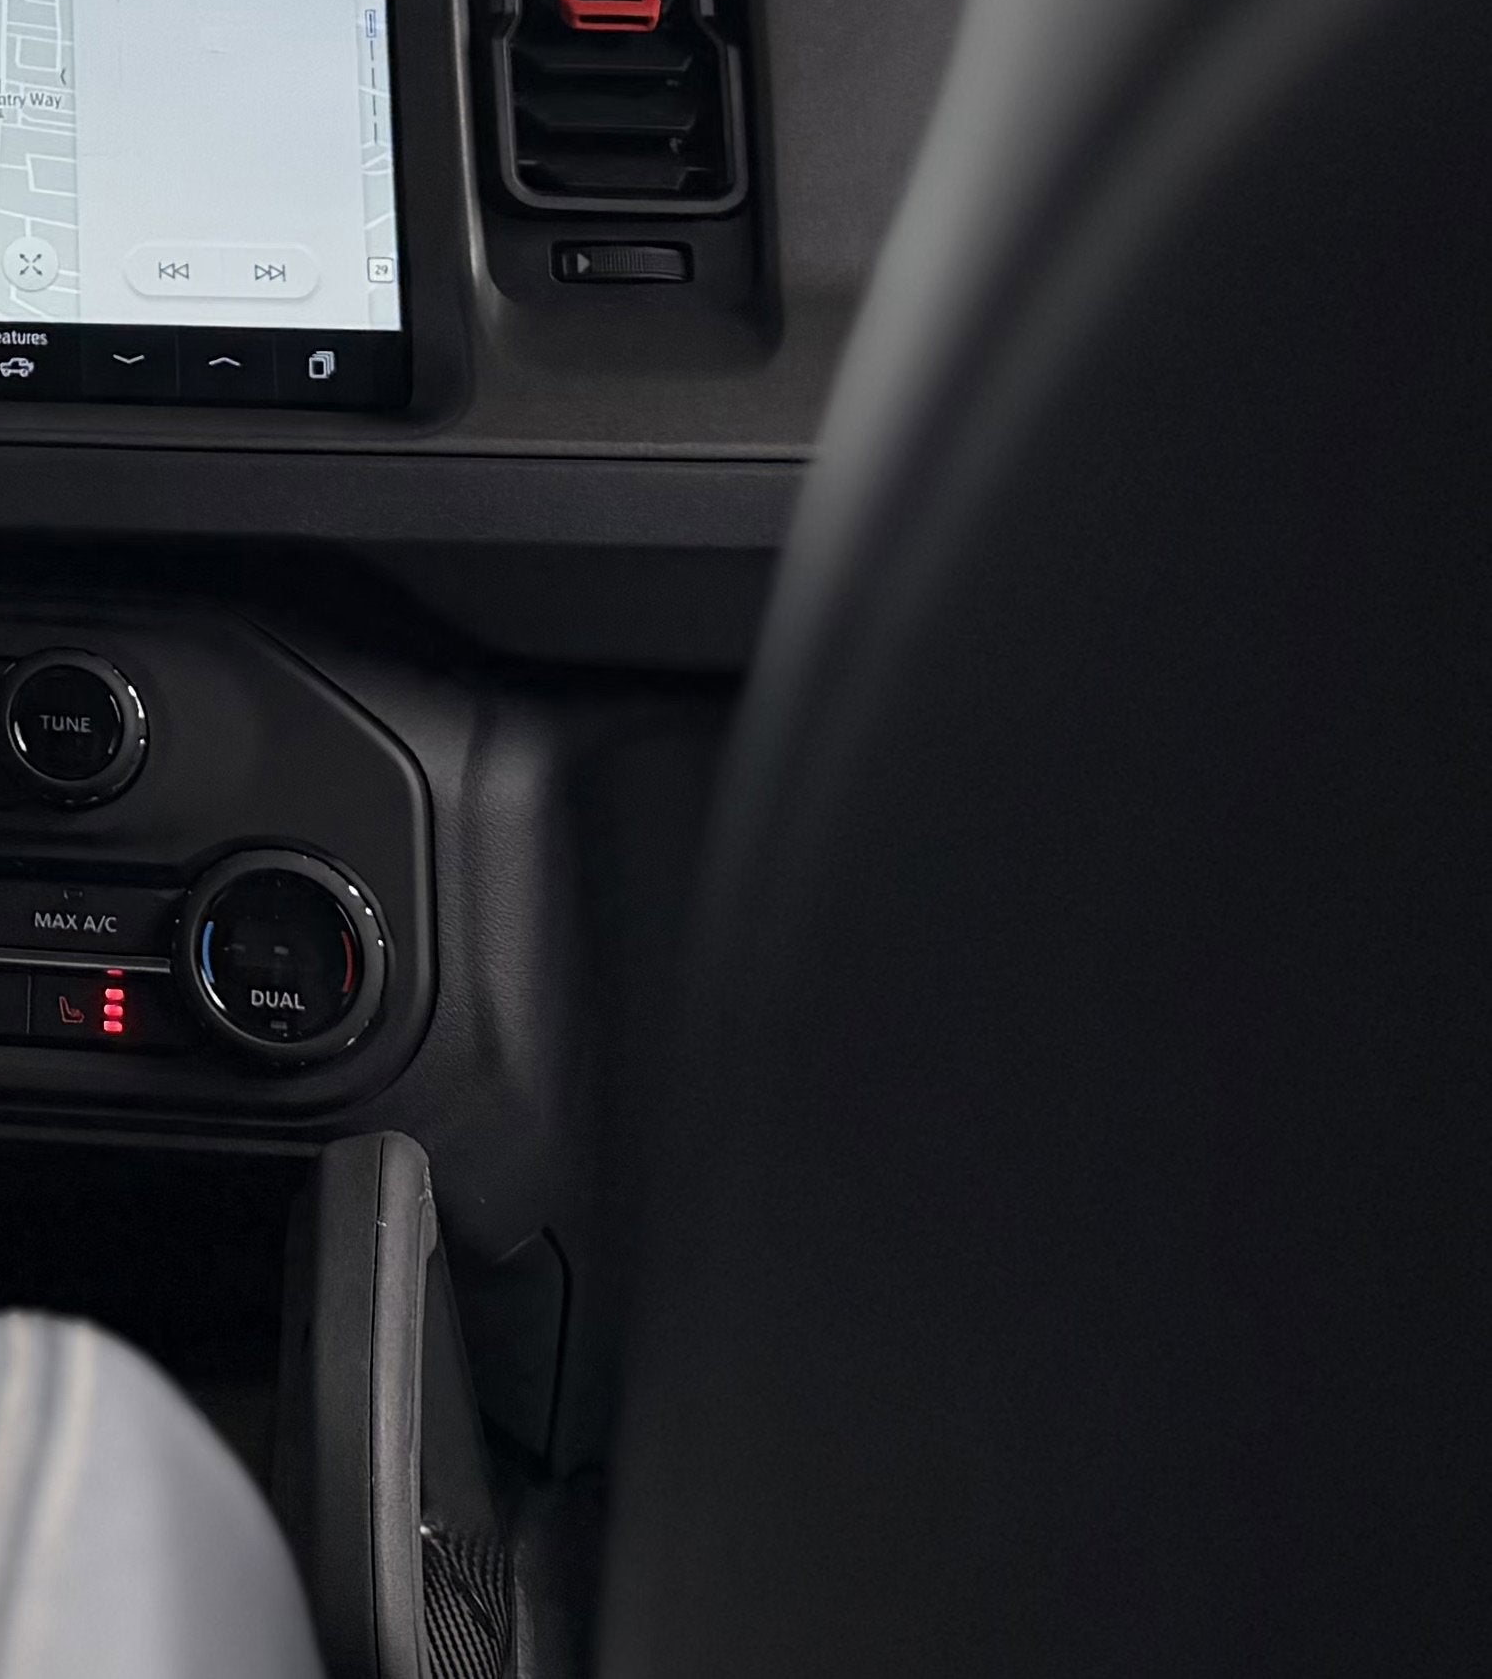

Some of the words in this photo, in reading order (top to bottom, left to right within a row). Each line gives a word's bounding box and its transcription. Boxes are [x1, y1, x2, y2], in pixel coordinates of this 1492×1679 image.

[29, 93, 63, 109] Way
[374, 264, 389, 276] 29
[39, 714, 92, 734] TUNE
[34, 912, 78, 931] MAX
[82, 915, 117, 934] A/C
[251, 989, 306, 1011] DUAL
